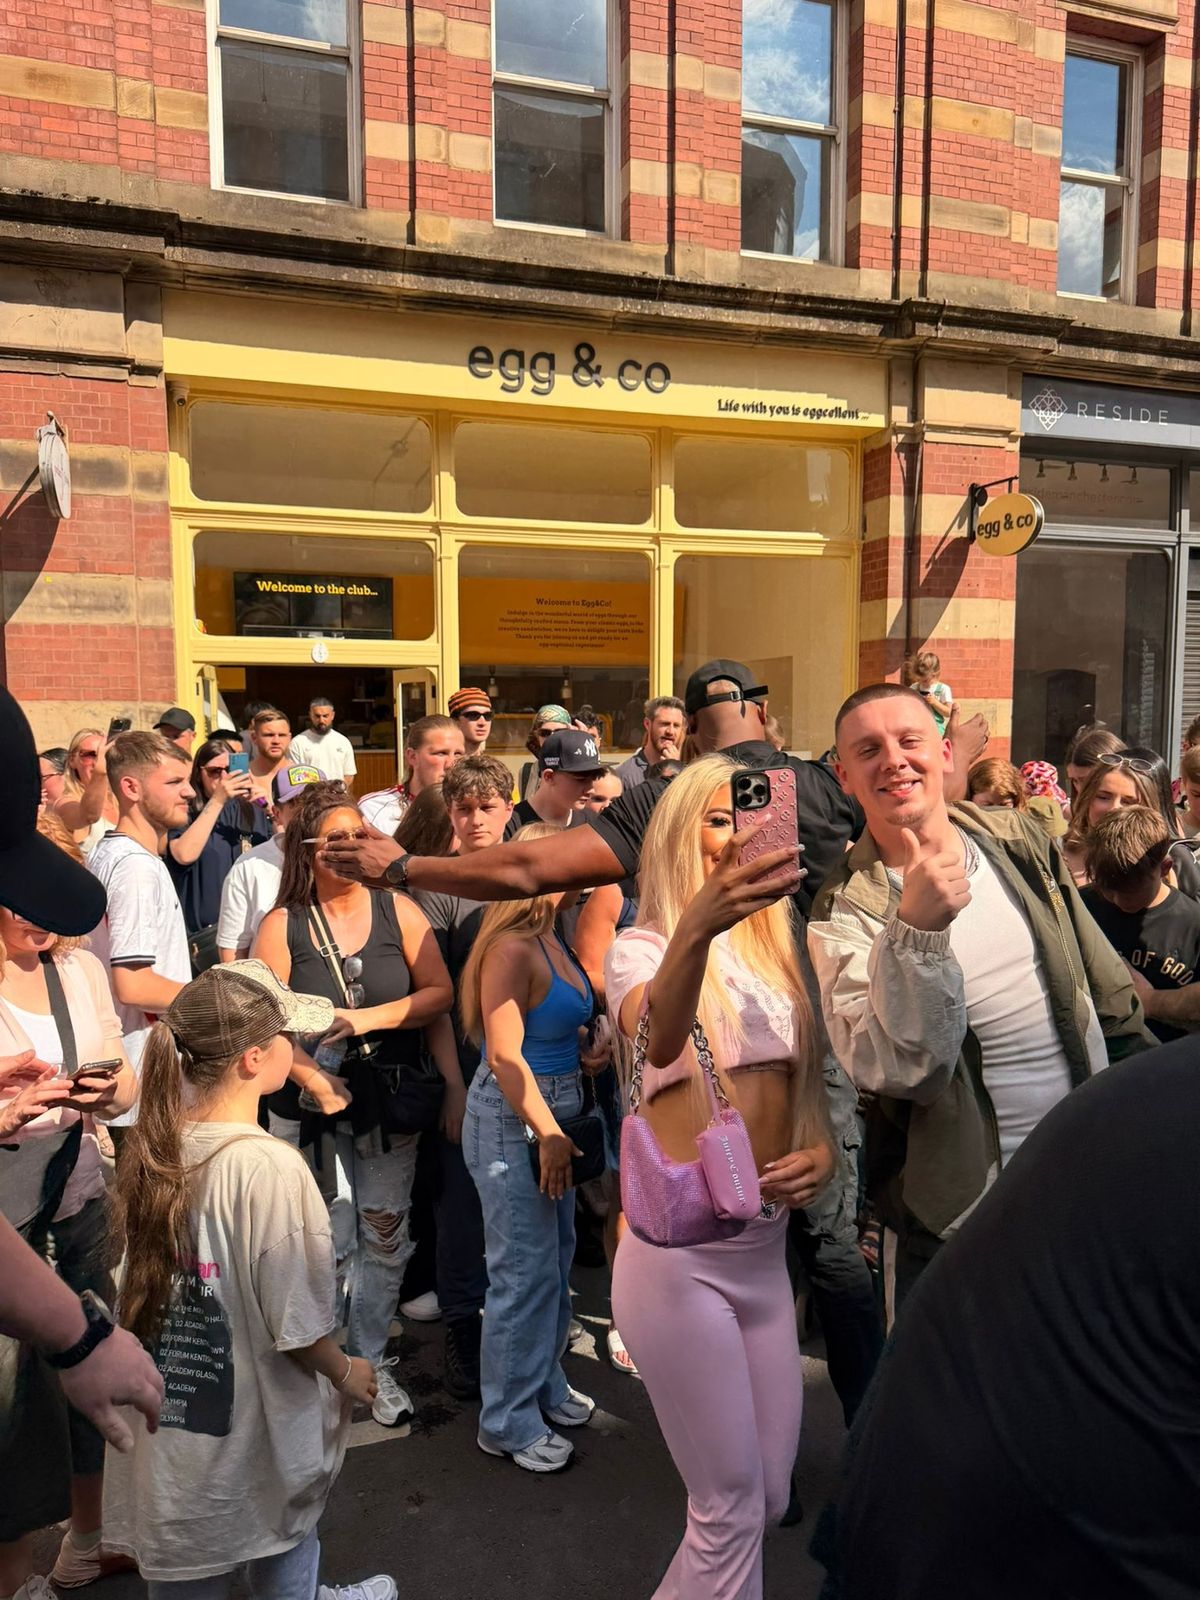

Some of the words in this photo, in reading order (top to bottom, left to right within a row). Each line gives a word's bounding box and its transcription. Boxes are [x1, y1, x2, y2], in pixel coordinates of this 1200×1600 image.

[468, 344, 555, 395] egg
[572, 341, 605, 388] &
[618, 358, 671, 393] co
[718, 399, 739, 412] Life
[742, 400, 767, 414] with
[769, 405, 790, 417] you
[791, 403, 801, 416] is
[1077, 402, 1169, 426] RESIDE
[977, 521, 1001, 539] egg
[1003, 513, 1014, 530] &
[1016, 513, 1033, 529] co
[256, 581, 312, 594] Welcome
[314, 584, 325, 594] to
[327, 583, 345, 595] the
[347, 584, 378, 596] club...
[536, 598, 571, 607] Welcome
[1131, 949, 1156, 969] OF
[1160, 957, 1194, 986] GOD
[168, 1349, 190, 1360] FORUM
[167, 1365, 196, 1377] ACADEMY
[168, 1382, 198, 1394] ACADEMY
